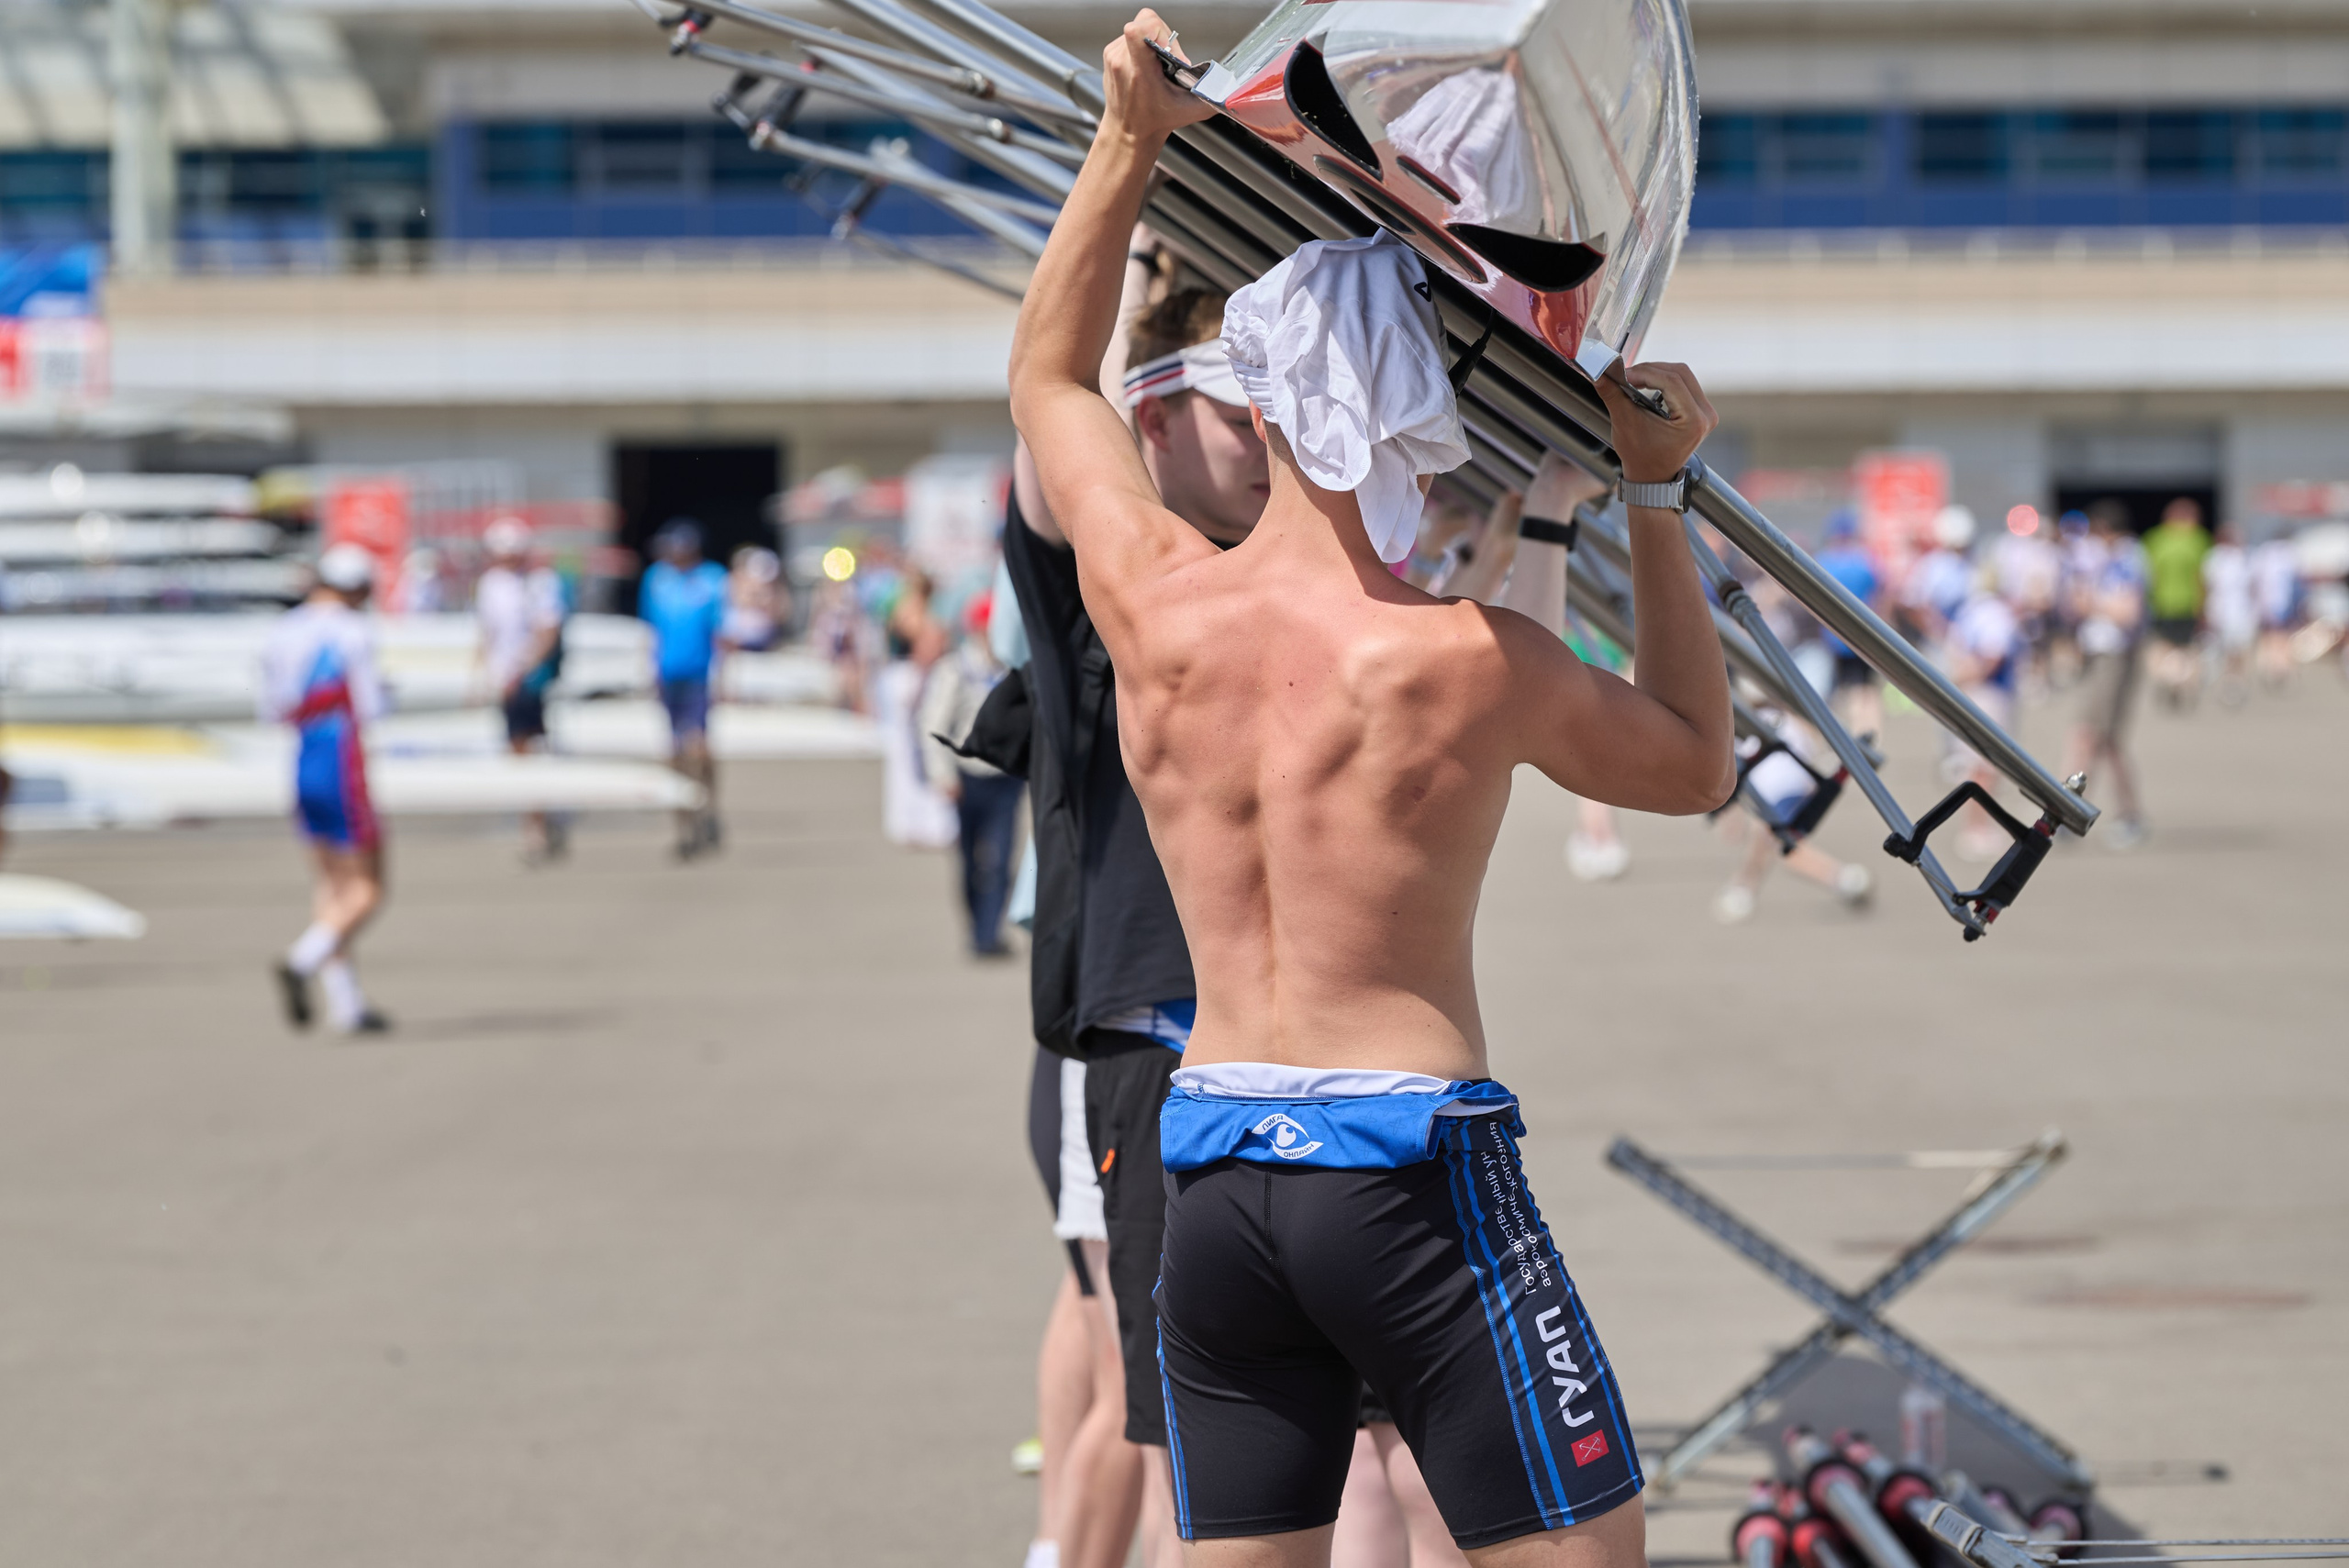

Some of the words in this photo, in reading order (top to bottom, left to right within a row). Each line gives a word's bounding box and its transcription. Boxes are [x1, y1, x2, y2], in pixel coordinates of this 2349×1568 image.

[1262, 1115, 1284, 1130] ЛИГА
[1283, 1143, 1315, 1158] ОНЛАЙН
[1535, 1305, 1595, 1428] ГУАП
